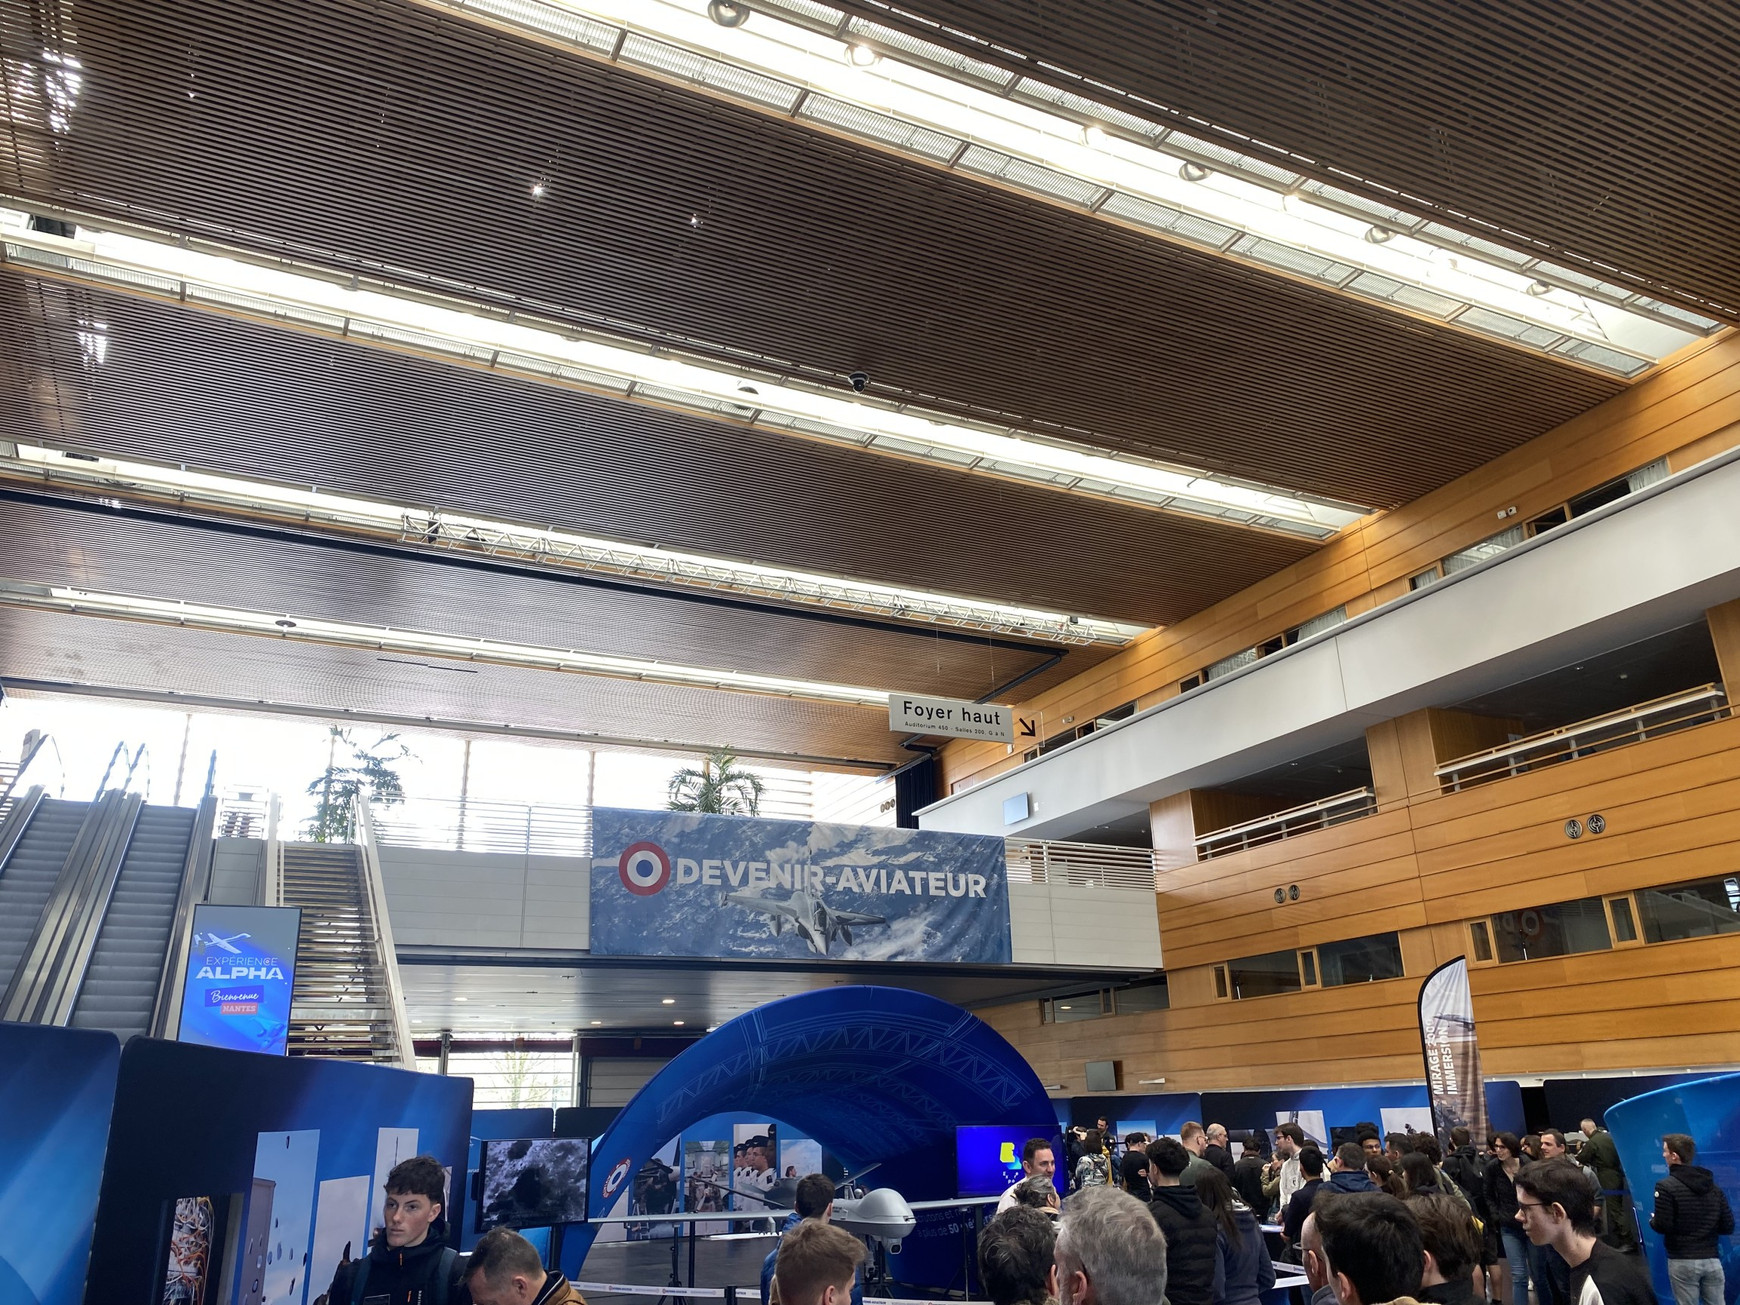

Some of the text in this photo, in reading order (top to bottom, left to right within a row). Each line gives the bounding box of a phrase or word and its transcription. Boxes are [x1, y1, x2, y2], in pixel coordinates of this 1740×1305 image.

[903, 700, 1001, 726] Foyer haut
[904, 721, 936, 730] Auditorium
[955, 726, 973, 734] Salles
[676, 857, 987, 899] DEVENIR-AVIATEUR
[195, 966, 284, 980] ALPHA
[211, 990, 259, 1004] Bienvenue
[222, 1005, 257, 1013] NANTES
[1437, 1026, 1458, 1095] IMMERSION
[1428, 1049, 1444, 1095] MIRAGE
[948, 1222, 960, 1234] 50
